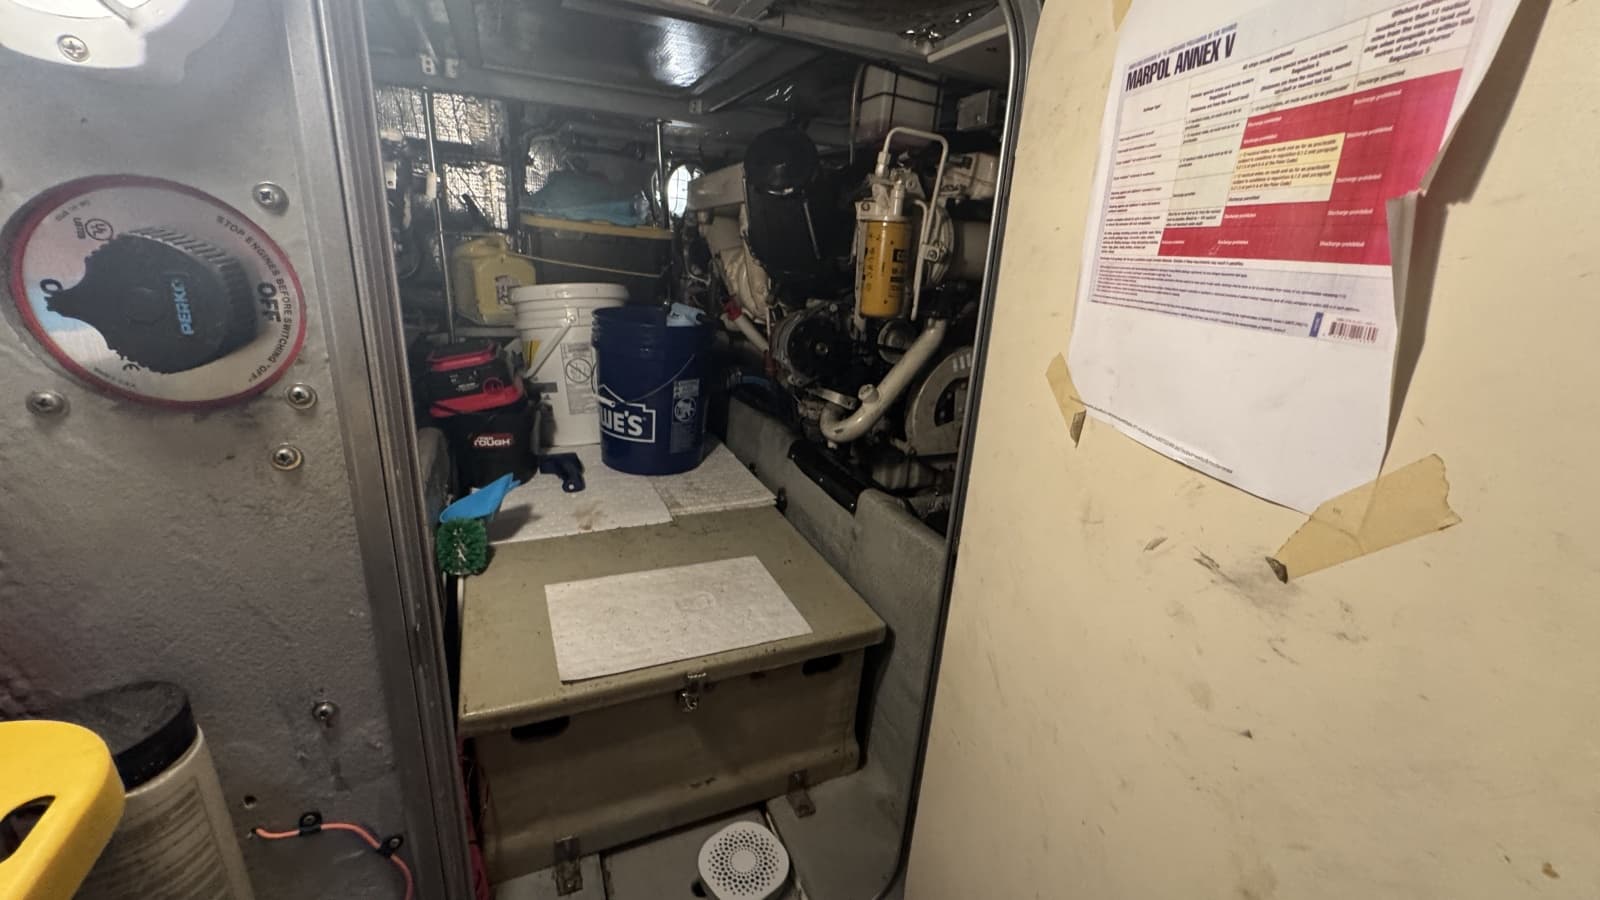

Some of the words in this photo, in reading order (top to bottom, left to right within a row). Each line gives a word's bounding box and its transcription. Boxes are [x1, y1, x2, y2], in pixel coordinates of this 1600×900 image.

[1126, 57, 1170, 92] MARPOL
[1174, 38, 1222, 75] ANNEX
[1225, 32, 1236, 58] V
[217, 216, 245, 236] STOP
[245, 236, 280, 276] ENGINES
[171, 280, 194, 336] PERKO
[258, 282, 281, 322] OFF
[276, 278, 292, 315] BEFORE
[268, 318, 292, 363] SWITCHING
[600, 408, 642, 436] WE'S
[473, 438, 511, 447] TOUGH
